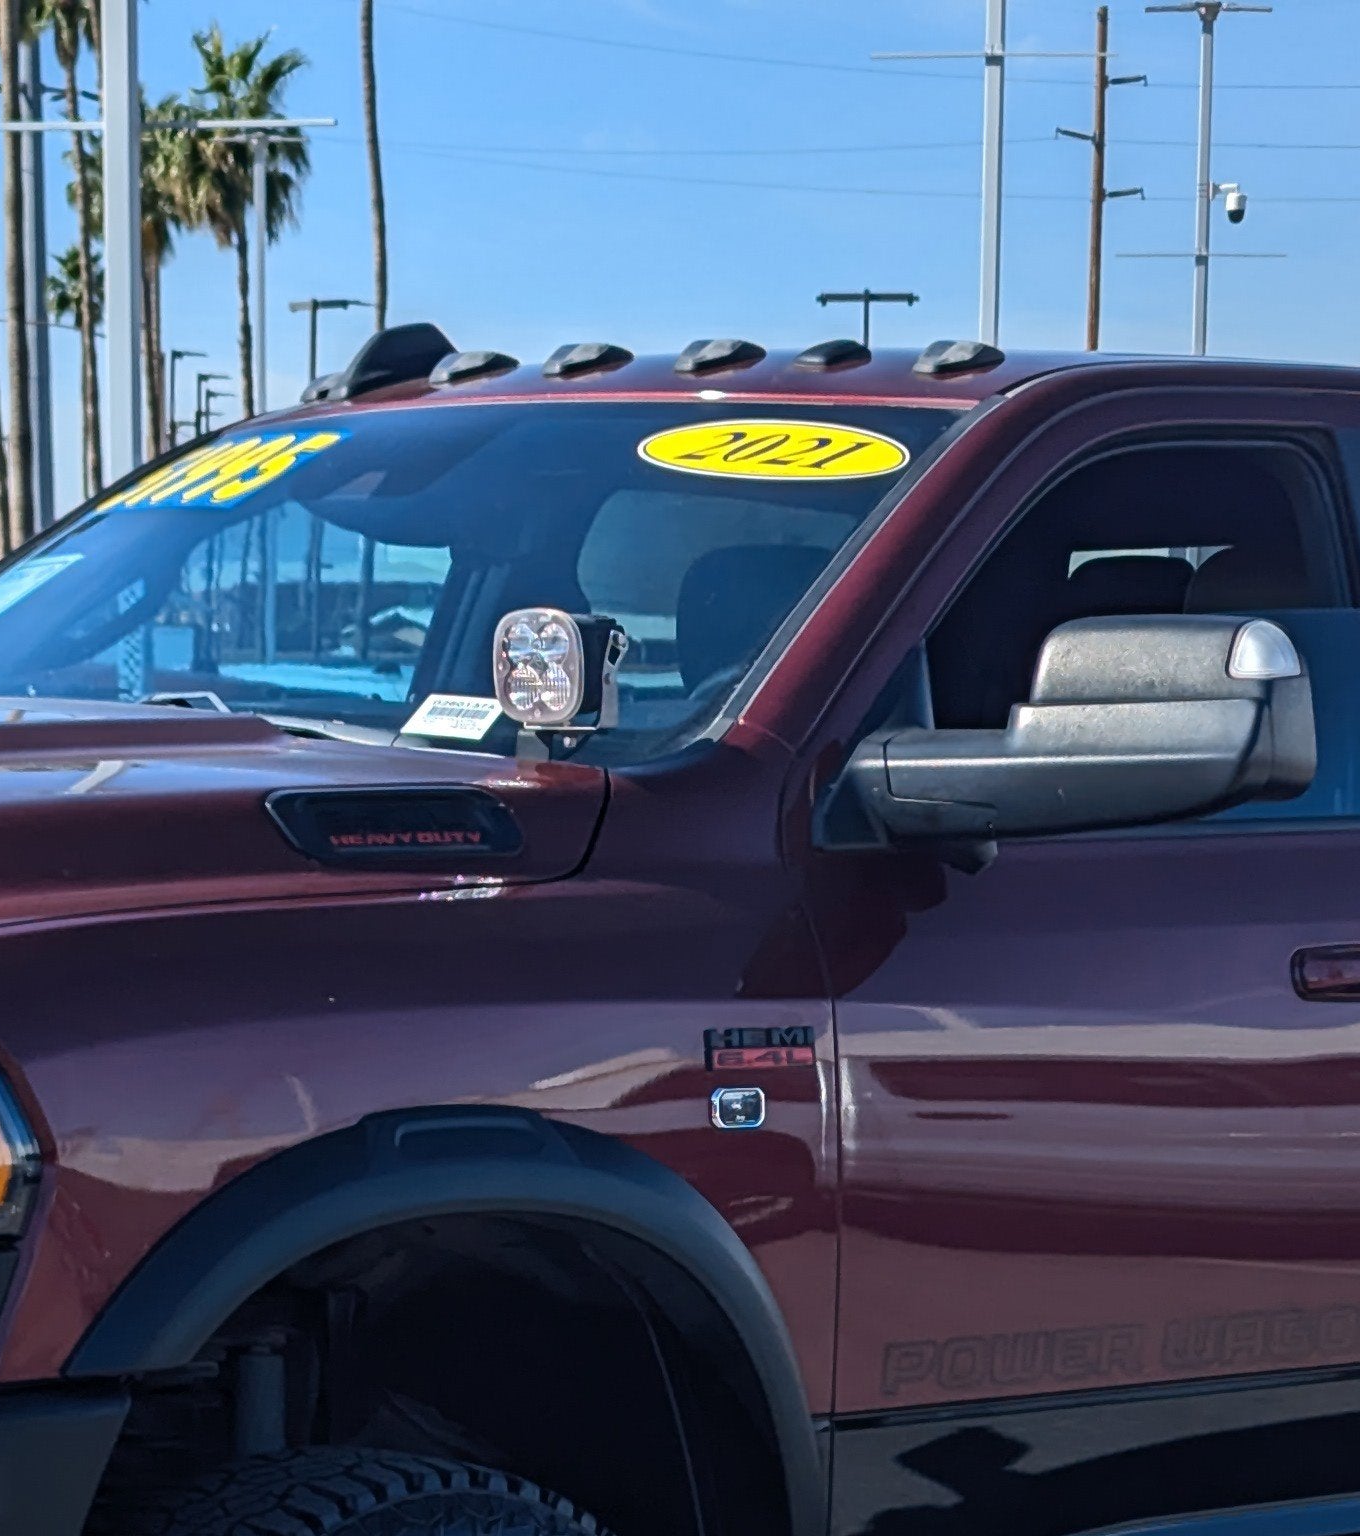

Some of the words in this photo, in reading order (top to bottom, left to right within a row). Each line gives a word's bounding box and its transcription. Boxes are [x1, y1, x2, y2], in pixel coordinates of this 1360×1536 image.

[673, 431, 873, 470] 2021
[329, 832, 413, 846] HEAVY
[415, 830, 481, 844] DUTY
[704, 1026, 815, 1050] HEMI
[880, 1324, 1142, 1395] POWER
